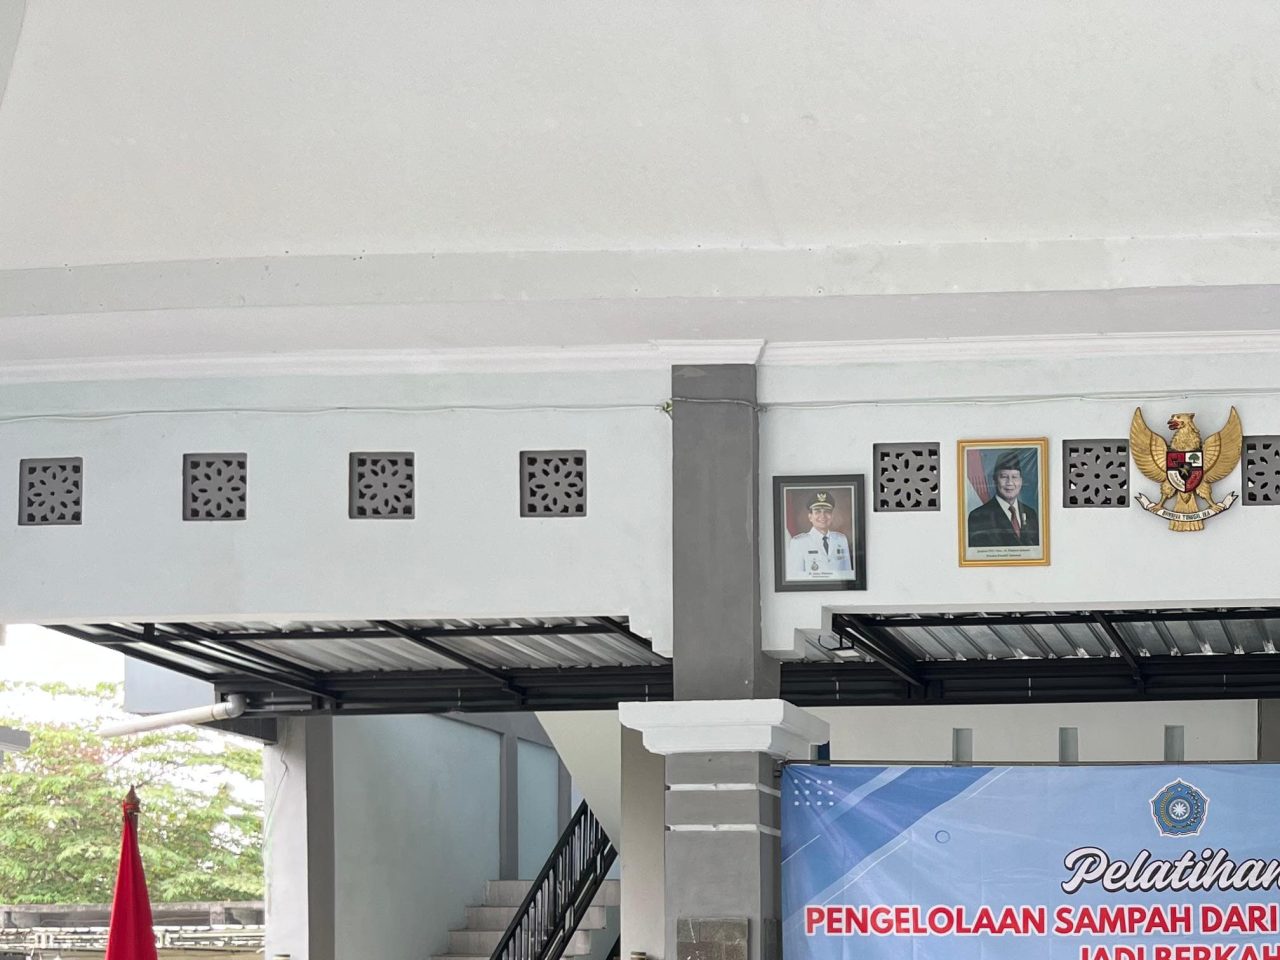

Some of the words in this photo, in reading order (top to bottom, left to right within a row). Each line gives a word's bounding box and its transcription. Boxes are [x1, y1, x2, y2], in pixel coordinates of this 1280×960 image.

[805, 906, 1046, 935] PENGELOLAAN
[1054, 905, 1192, 934] SAMPAH
[1201, 904, 1278, 932] DARI
